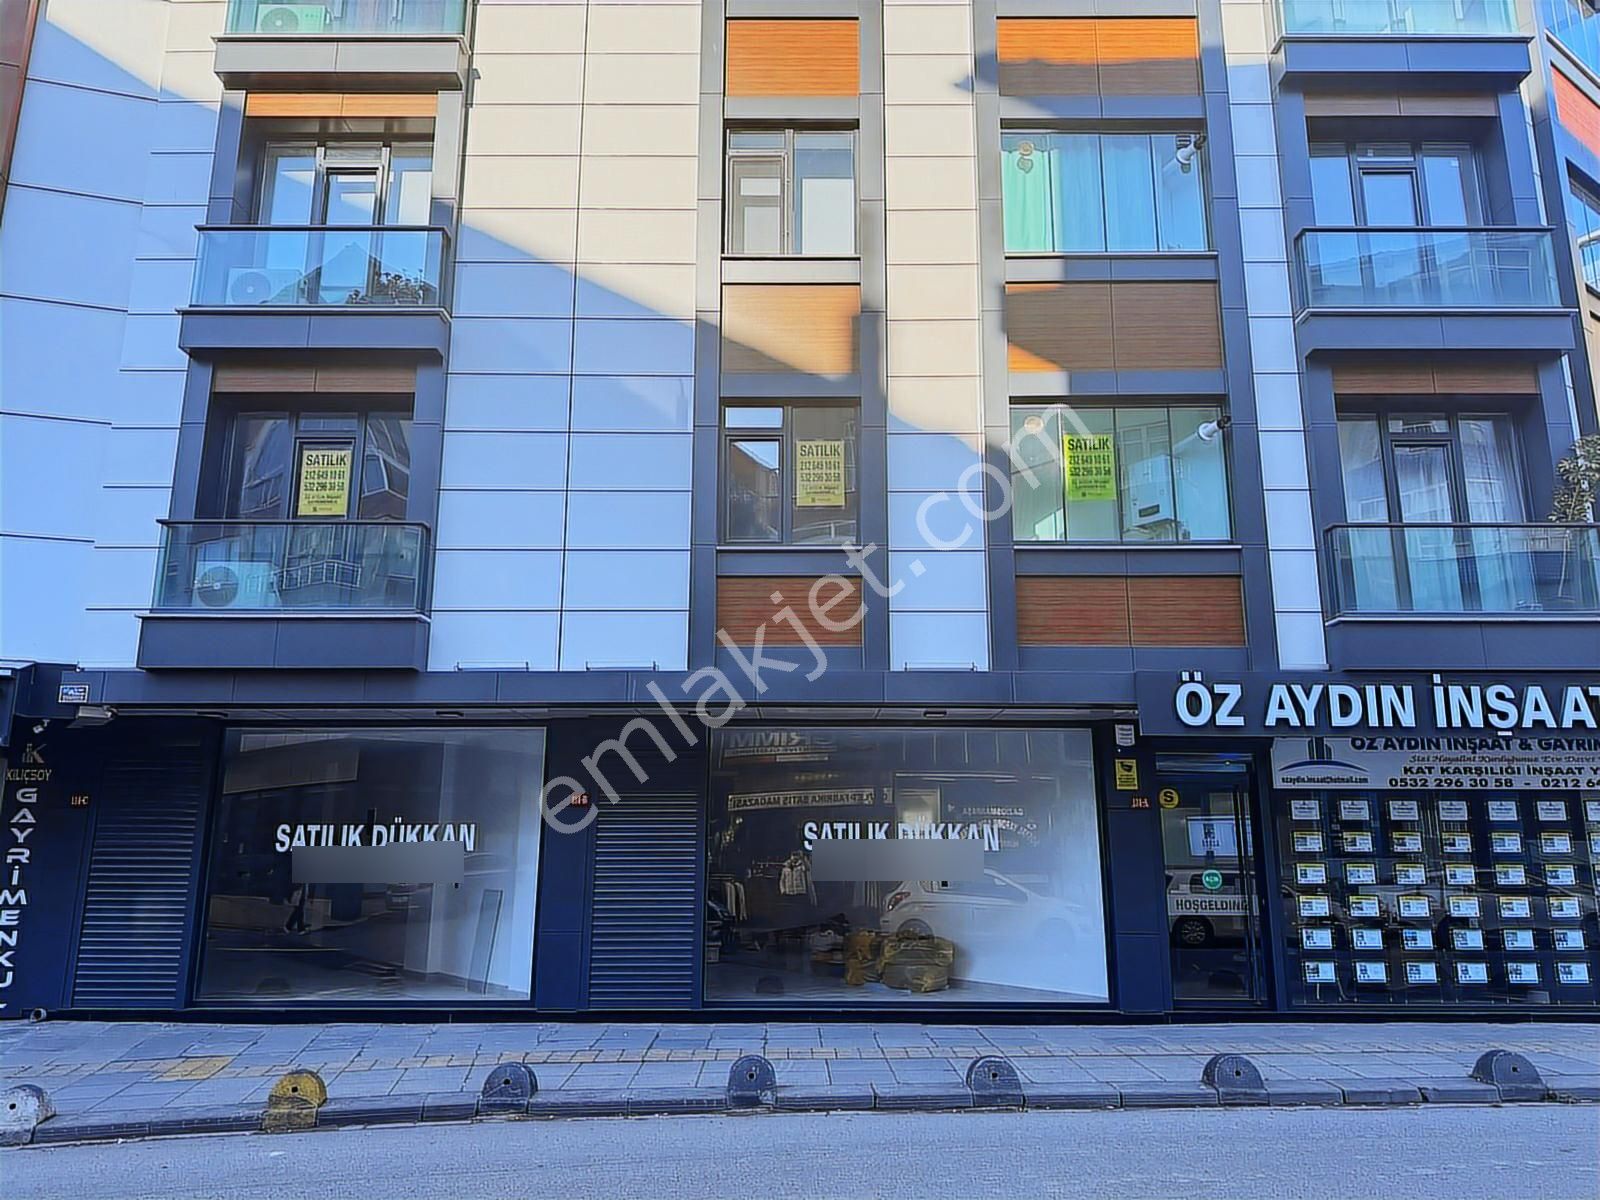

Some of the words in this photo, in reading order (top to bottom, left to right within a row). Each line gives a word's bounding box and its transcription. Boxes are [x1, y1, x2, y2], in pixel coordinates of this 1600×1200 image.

[799, 444, 841, 457] SATILIK
[1067, 438, 1110, 450] SATILIK
[305, 454, 347, 466] SATILIK
[1175, 672, 1245, 727] ÖZ
[1264, 684, 1416, 729] AYDIN
[1383, 737, 1441, 751] AYDIN
[1518, 738, 1533, 751] &
[1403, 765, 1435, 775] KAT
[1440, 764, 1521, 777] KARŞILIĞI
[1526, 764, 1584, 777] İNŞAAT
[1388, 777, 1429, 788] 0532
[1433, 777, 1464, 788] 296
[1469, 777, 1488, 788] 30
[1494, 777, 1514, 788] 58
[1540, 777, 1581, 788] 0212
[1163, 790, 1174, 803] S
